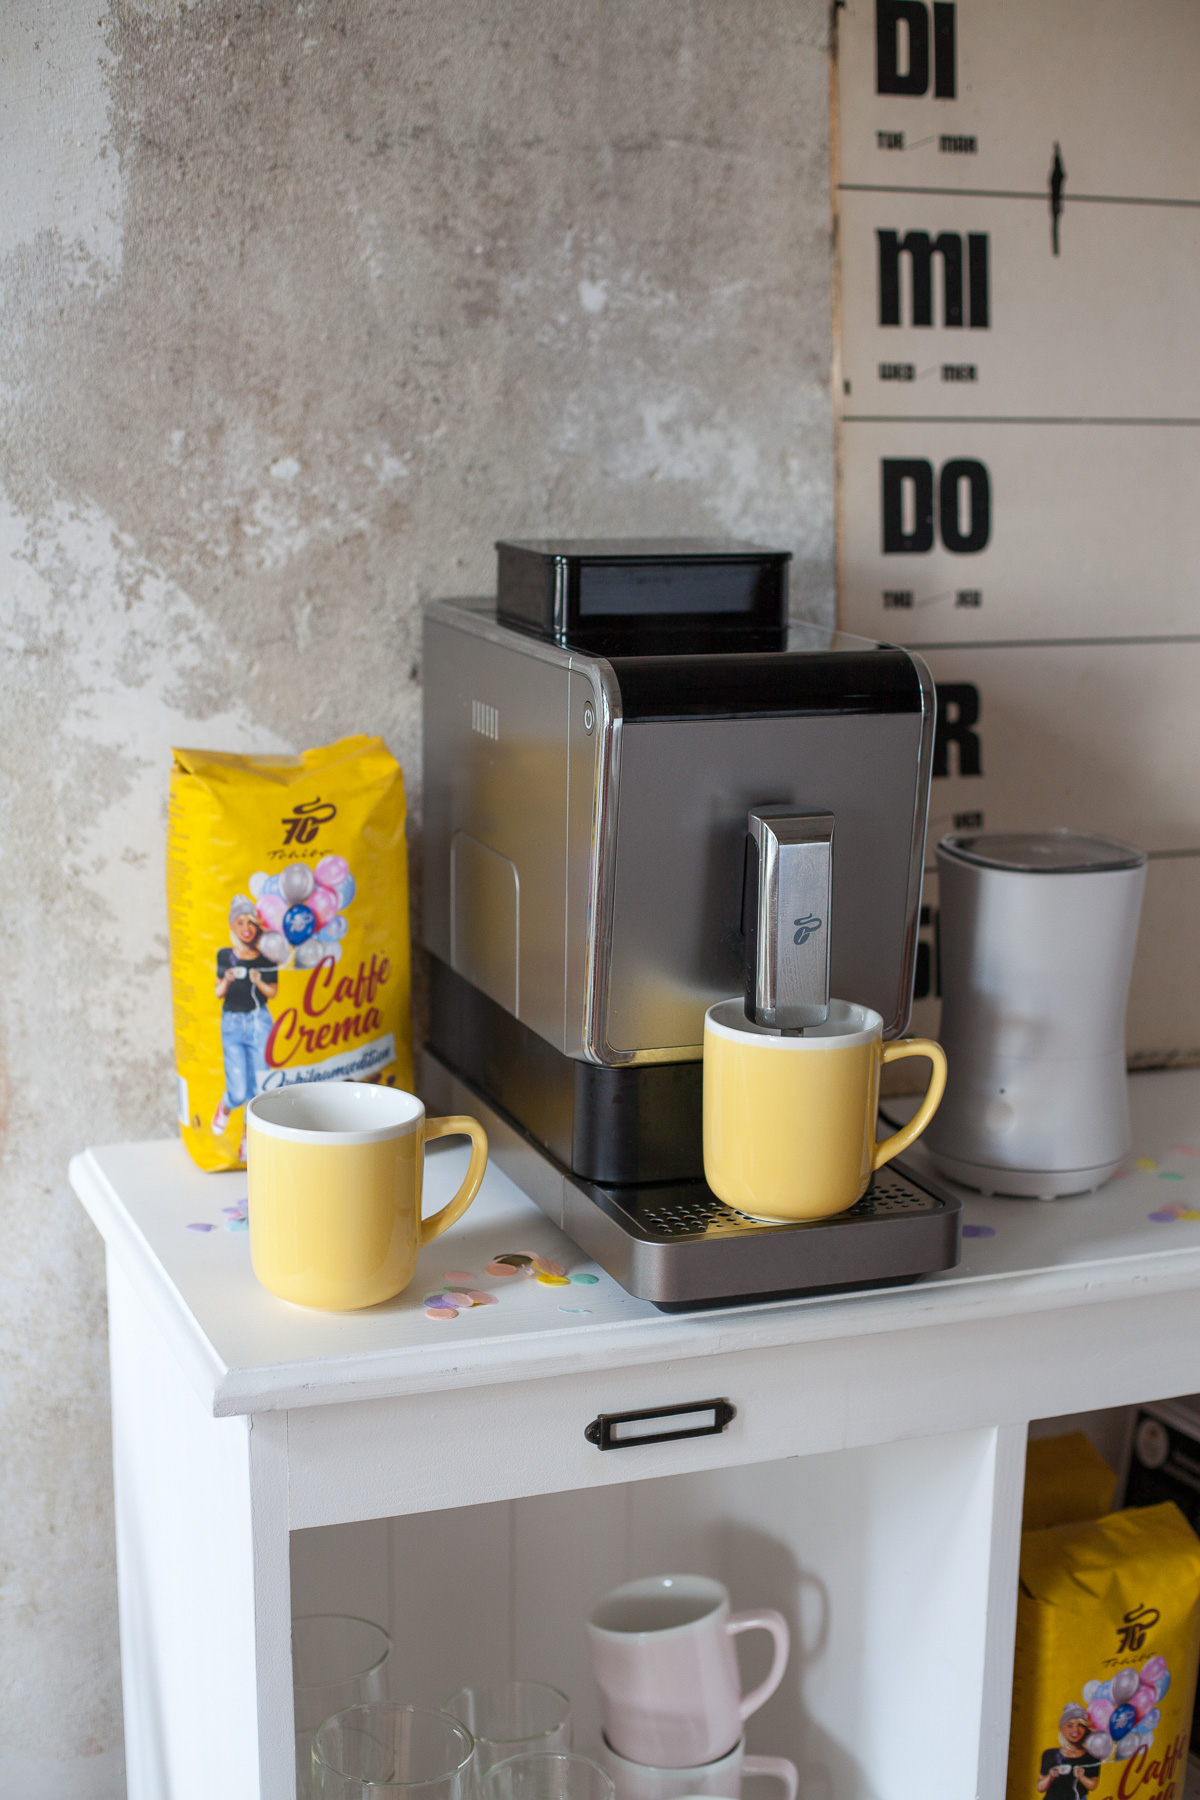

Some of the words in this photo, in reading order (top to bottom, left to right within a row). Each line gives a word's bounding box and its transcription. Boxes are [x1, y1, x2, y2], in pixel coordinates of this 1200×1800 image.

[876, 0, 957, 99] DI
[881, 457, 991, 555] DO
[932, 682, 982, 778] R
[265, 1008, 380, 1068] Crema
